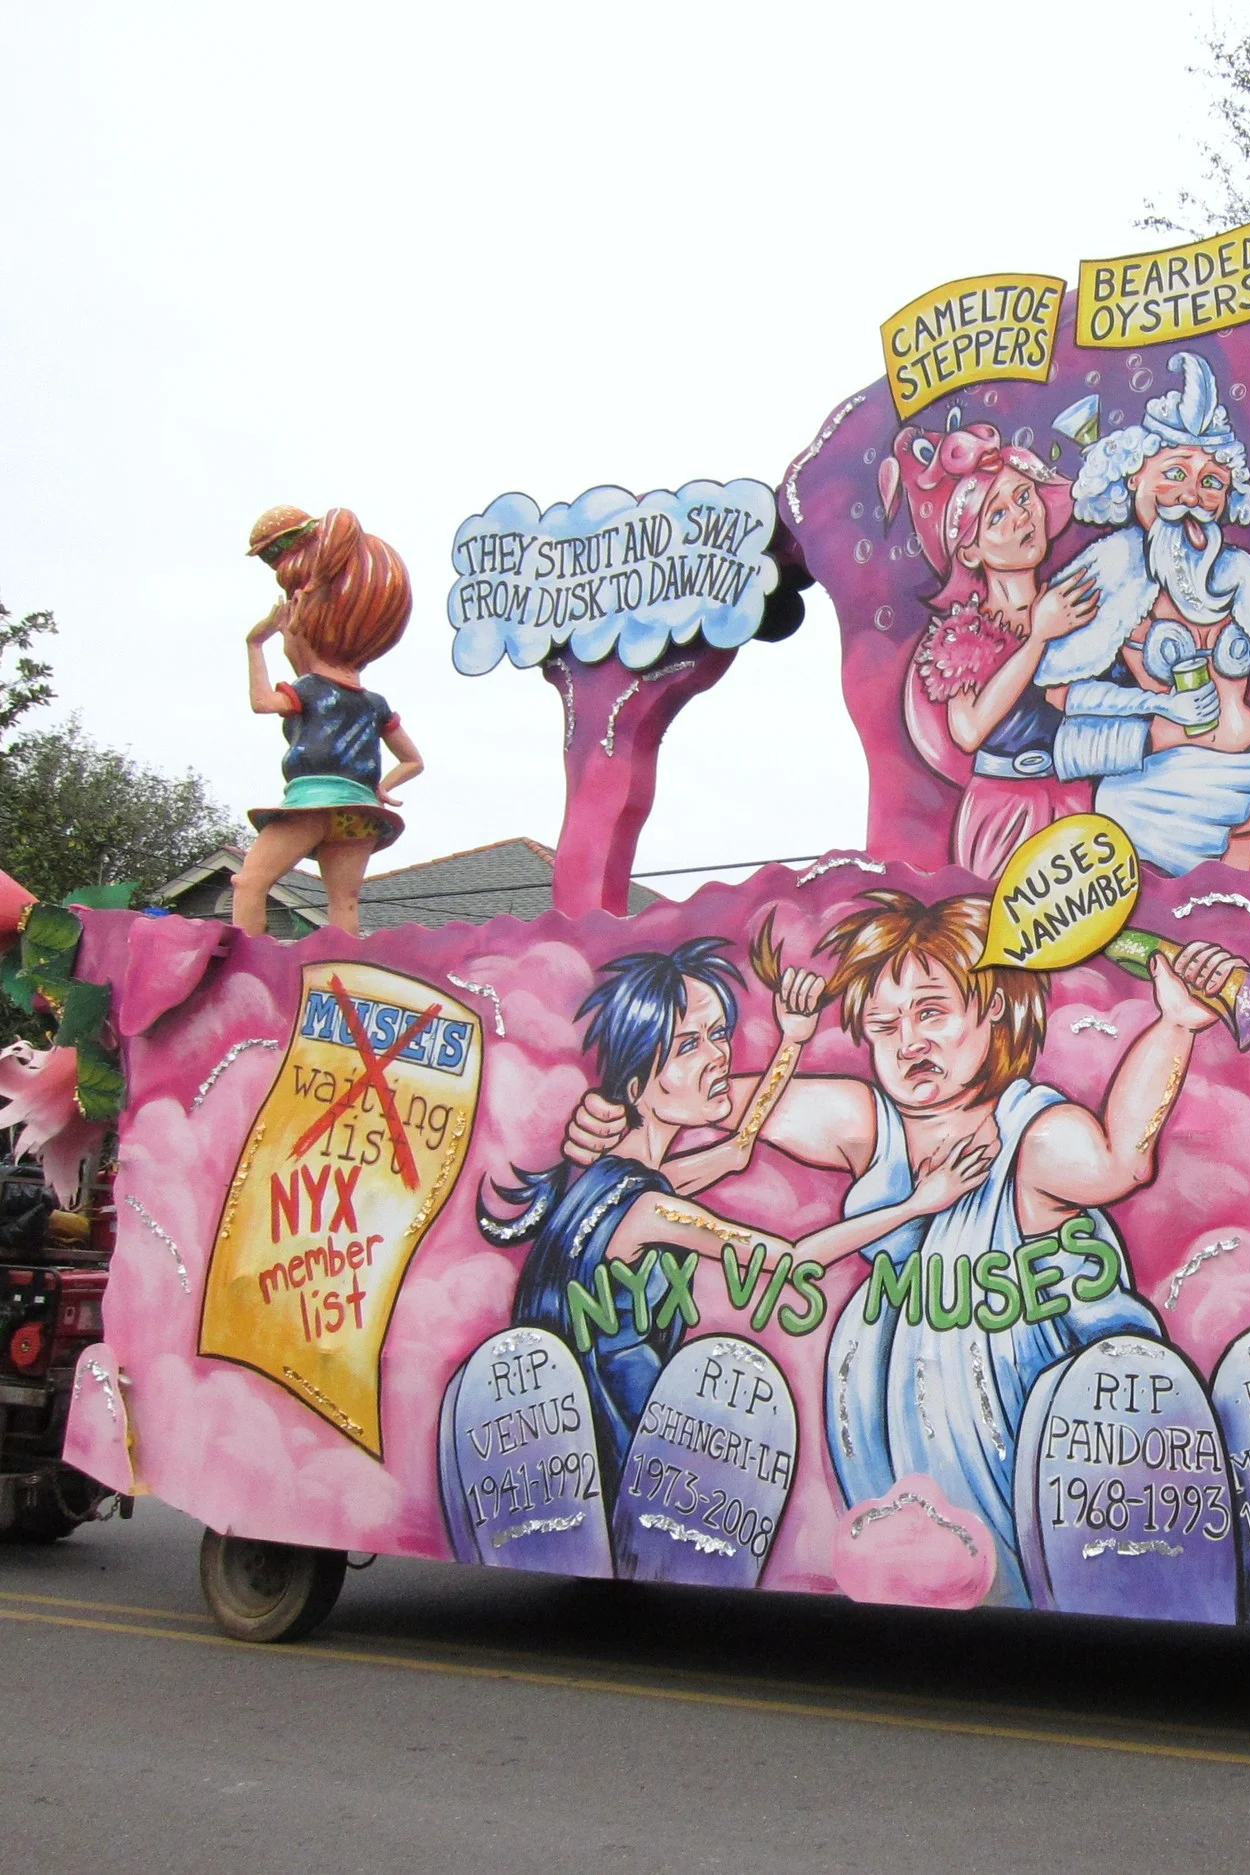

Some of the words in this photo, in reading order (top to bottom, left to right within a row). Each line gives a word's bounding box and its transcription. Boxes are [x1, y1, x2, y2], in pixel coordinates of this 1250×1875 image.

[891, 284, 1059, 358] CAMELTOE
[895, 321, 1048, 400] STEPPERS
[458, 532, 538, 576] THEY
[535, 528, 620, 580] STRUT
[621, 514, 673, 565] AND
[683, 504, 765, 556] SWAY
[459, 580, 533, 624] FROM
[534, 576, 608, 628] DUSK
[610, 568, 643, 614] TO
[647, 553, 761, 607] DAWNIN'
[1003, 832, 1116, 924] MUSES
[1003, 855, 1138, 962] WANNABE!
[302, 992, 468, 1068] MUSES
[294, 1065, 454, 1151] waiting
[320, 1111, 405, 1175] list
[270, 1163, 362, 1244] NYX
[259, 1232, 384, 1304] member
[566, 1246, 702, 1354] NYX
[863, 1216, 1124, 1334] MUSES
[299, 1273, 367, 1342] list
[466, 1392, 581, 1460] VENUS
[640, 1400, 792, 1490] SHANGRI-LA
[1045, 1416, 1224, 1474] PANDORA
[467, 1452, 600, 1527] 1941-1992
[629, 1453, 774, 1558] 1973-2008
[1047, 1476, 1232, 1541] 1968-1993
